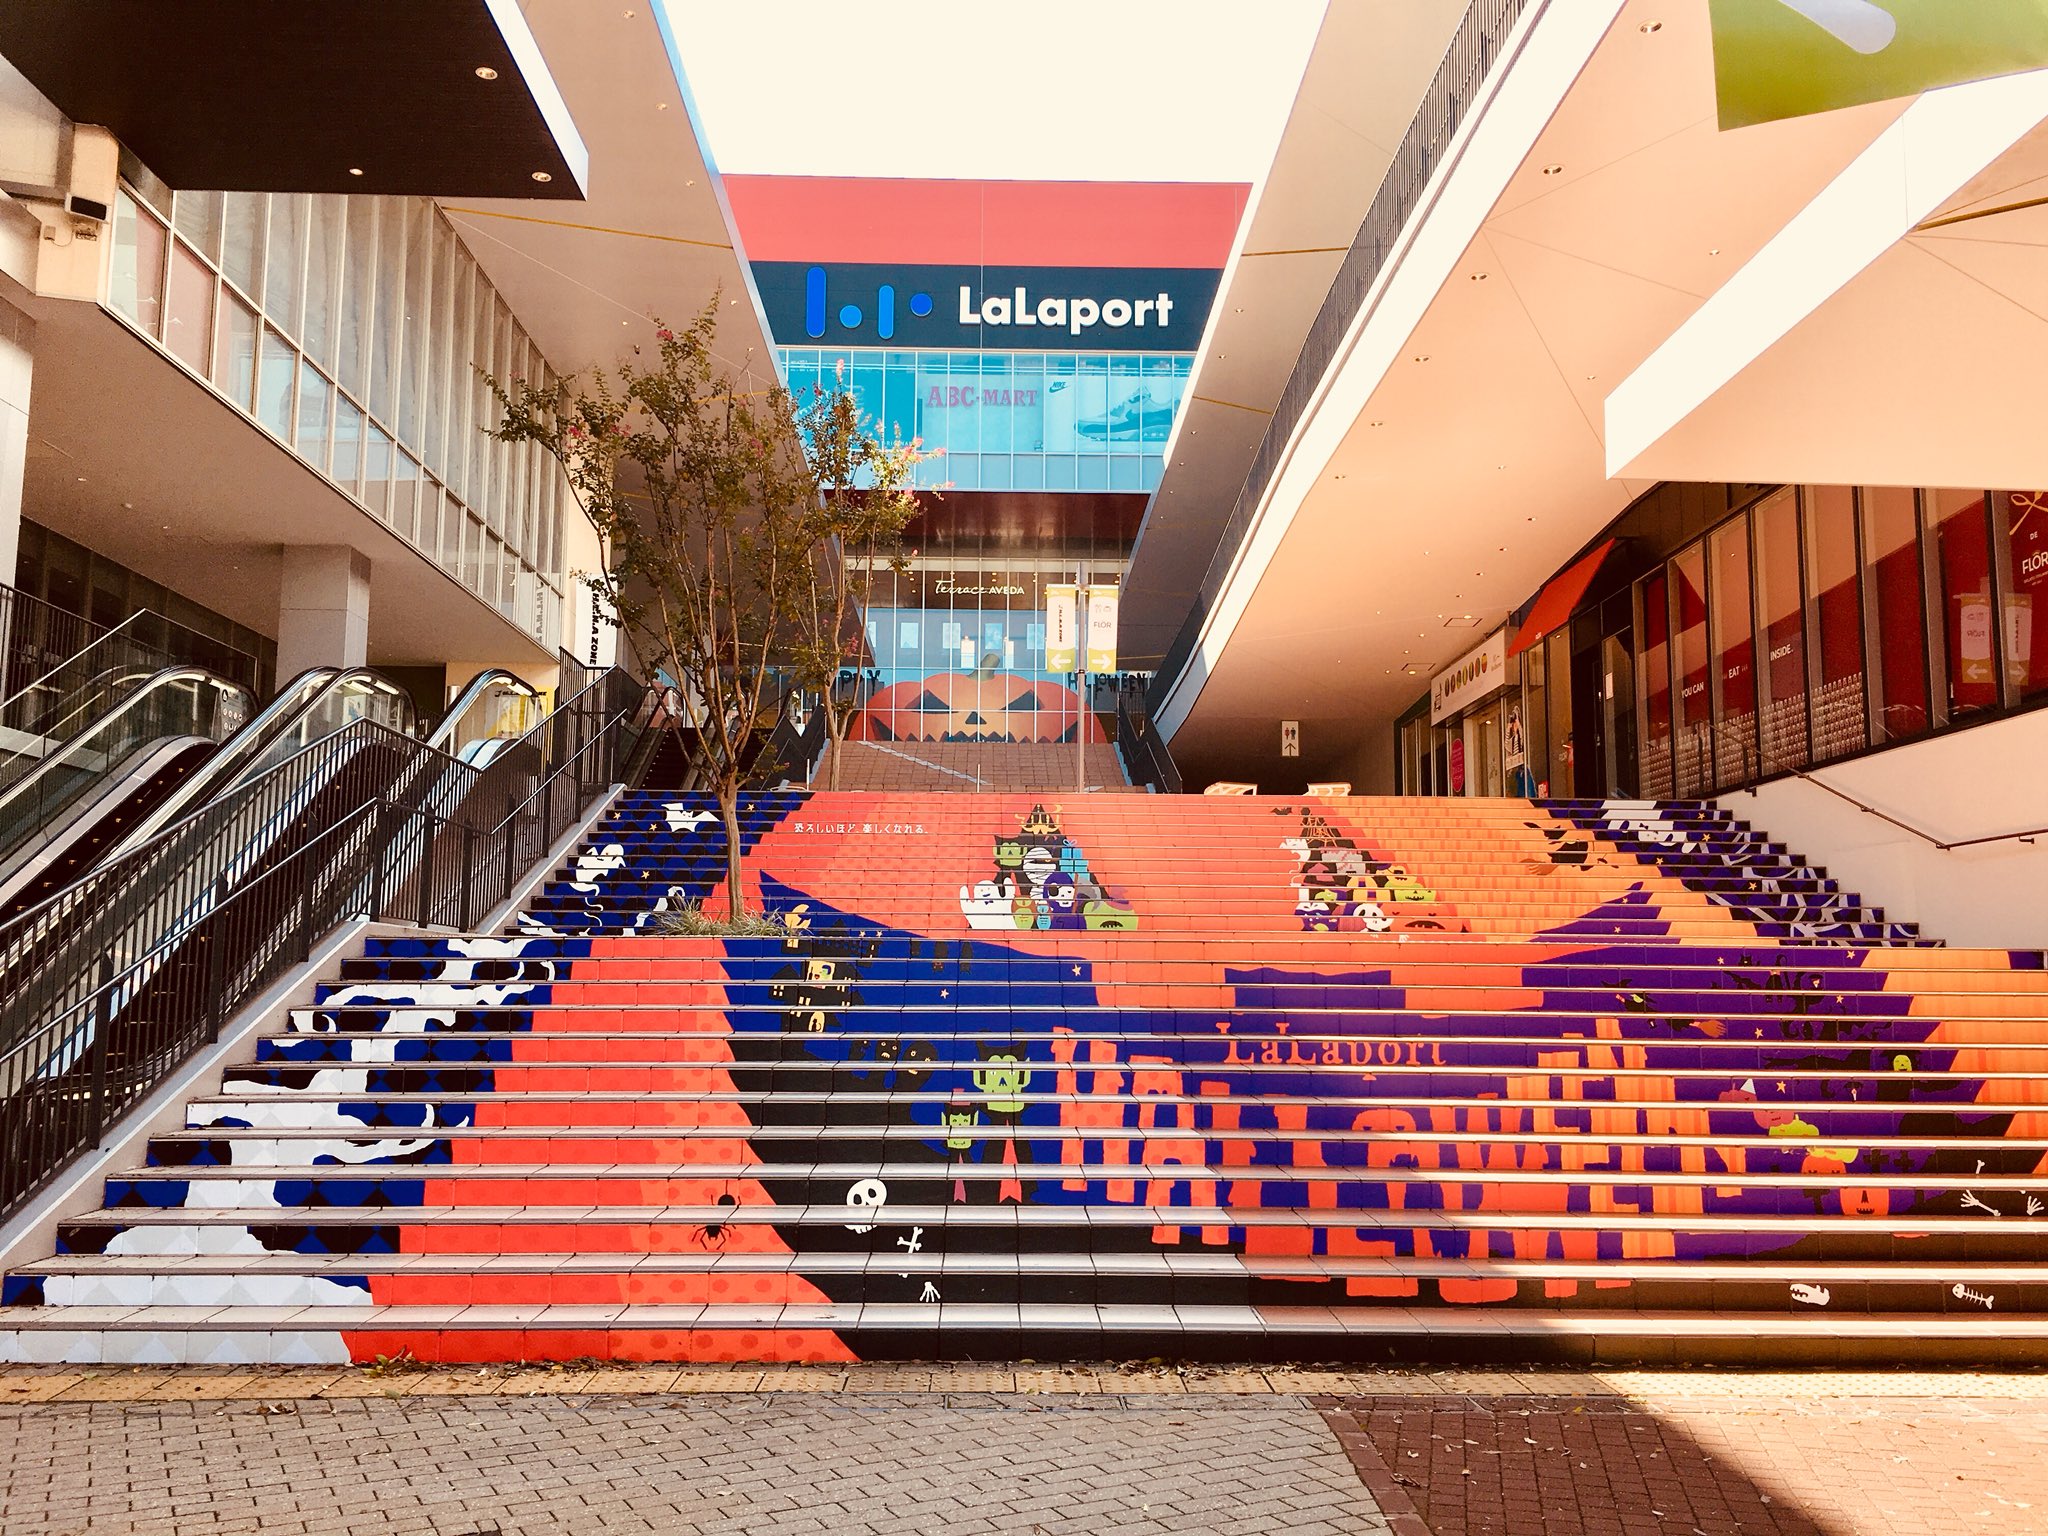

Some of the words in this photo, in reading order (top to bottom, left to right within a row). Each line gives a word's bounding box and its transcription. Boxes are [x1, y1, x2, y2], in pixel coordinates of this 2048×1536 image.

[959, 286, 1173, 335] LaLaport
[2029, 531, 2039, 540] DE
[935, 580, 988, 594] Terrace
[988, 586, 1025, 595] AVEDA
[1093, 621, 1112, 629] FLOR
[589, 636, 599, 666] ZONE
[1067, 671, 1148, 698] HLLOWEEN
[1681, 686, 1693, 699] YOU
[1693, 681, 1705, 694] CAN
[1728, 666, 1740, 679] EAT
[1052, 1018, 1746, 1303] HALLOWEEN
